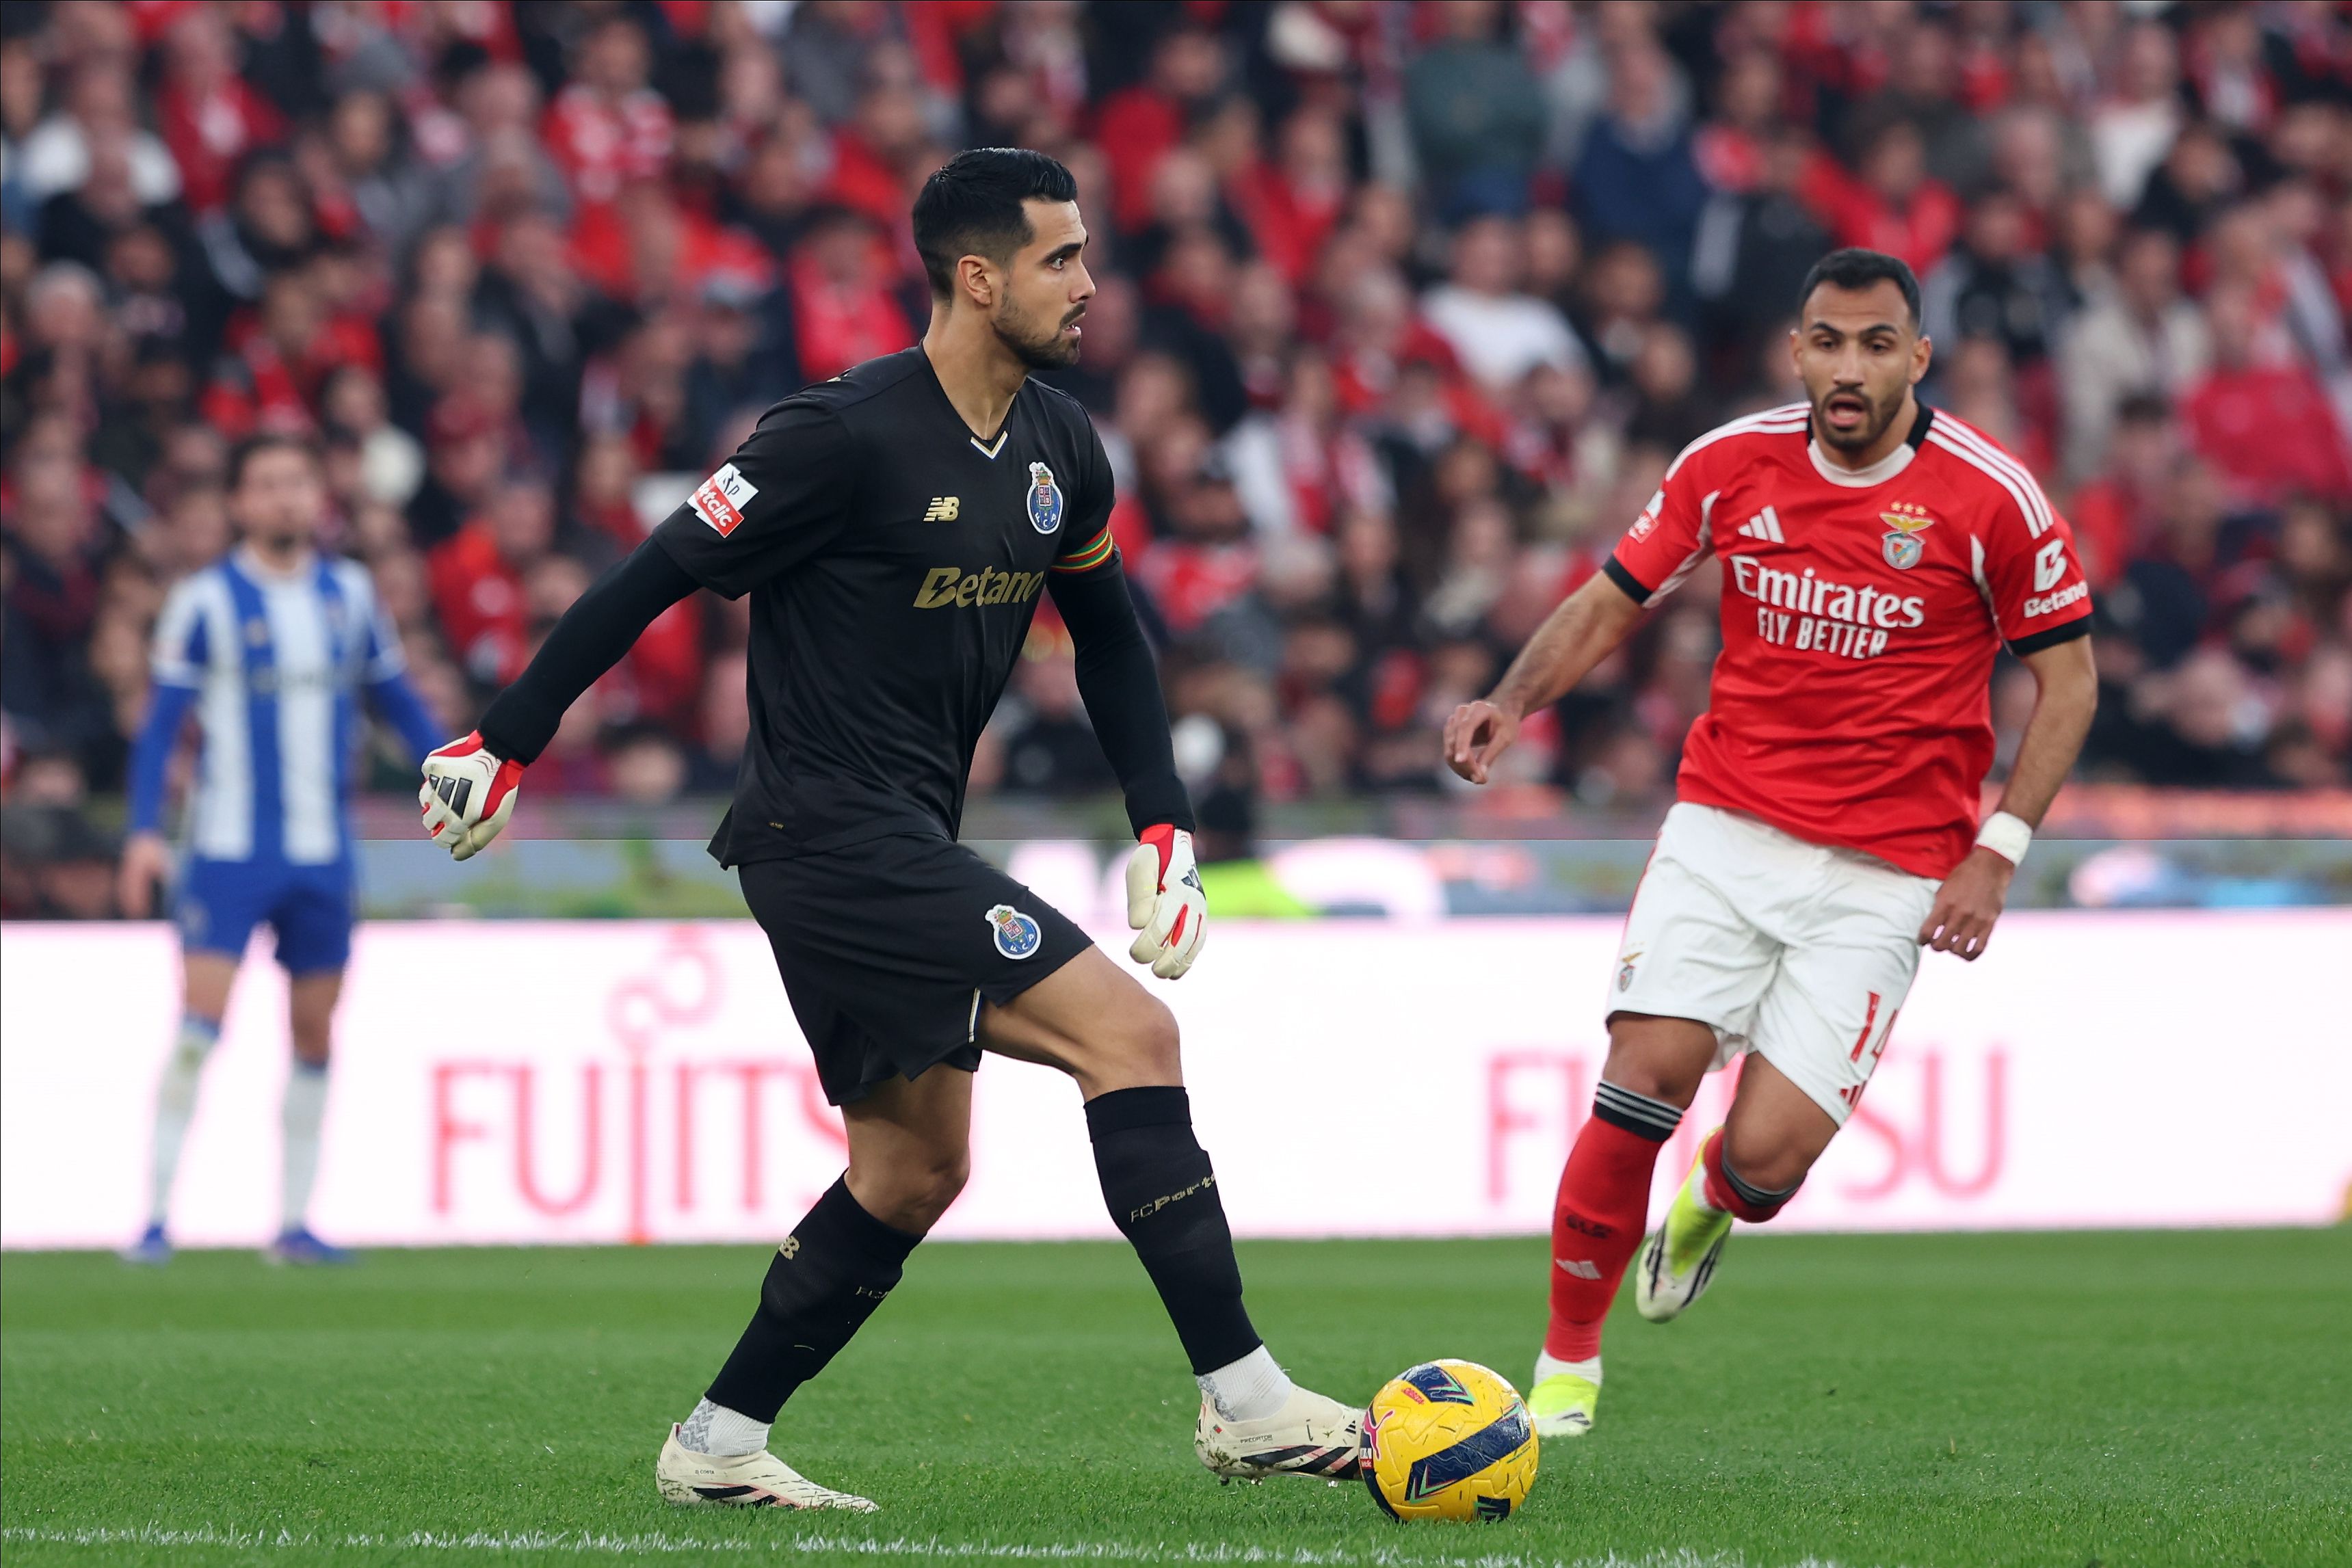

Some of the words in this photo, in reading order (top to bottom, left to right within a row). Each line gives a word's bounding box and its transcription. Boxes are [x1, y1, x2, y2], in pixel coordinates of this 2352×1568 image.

[913, 566, 1044, 609] Betano
[1730, 555, 1925, 628] Emirates
[2024, 580, 2088, 618] Betano
[1757, 607, 1791, 645] FLY
[1795, 616, 1888, 659] BETTER
